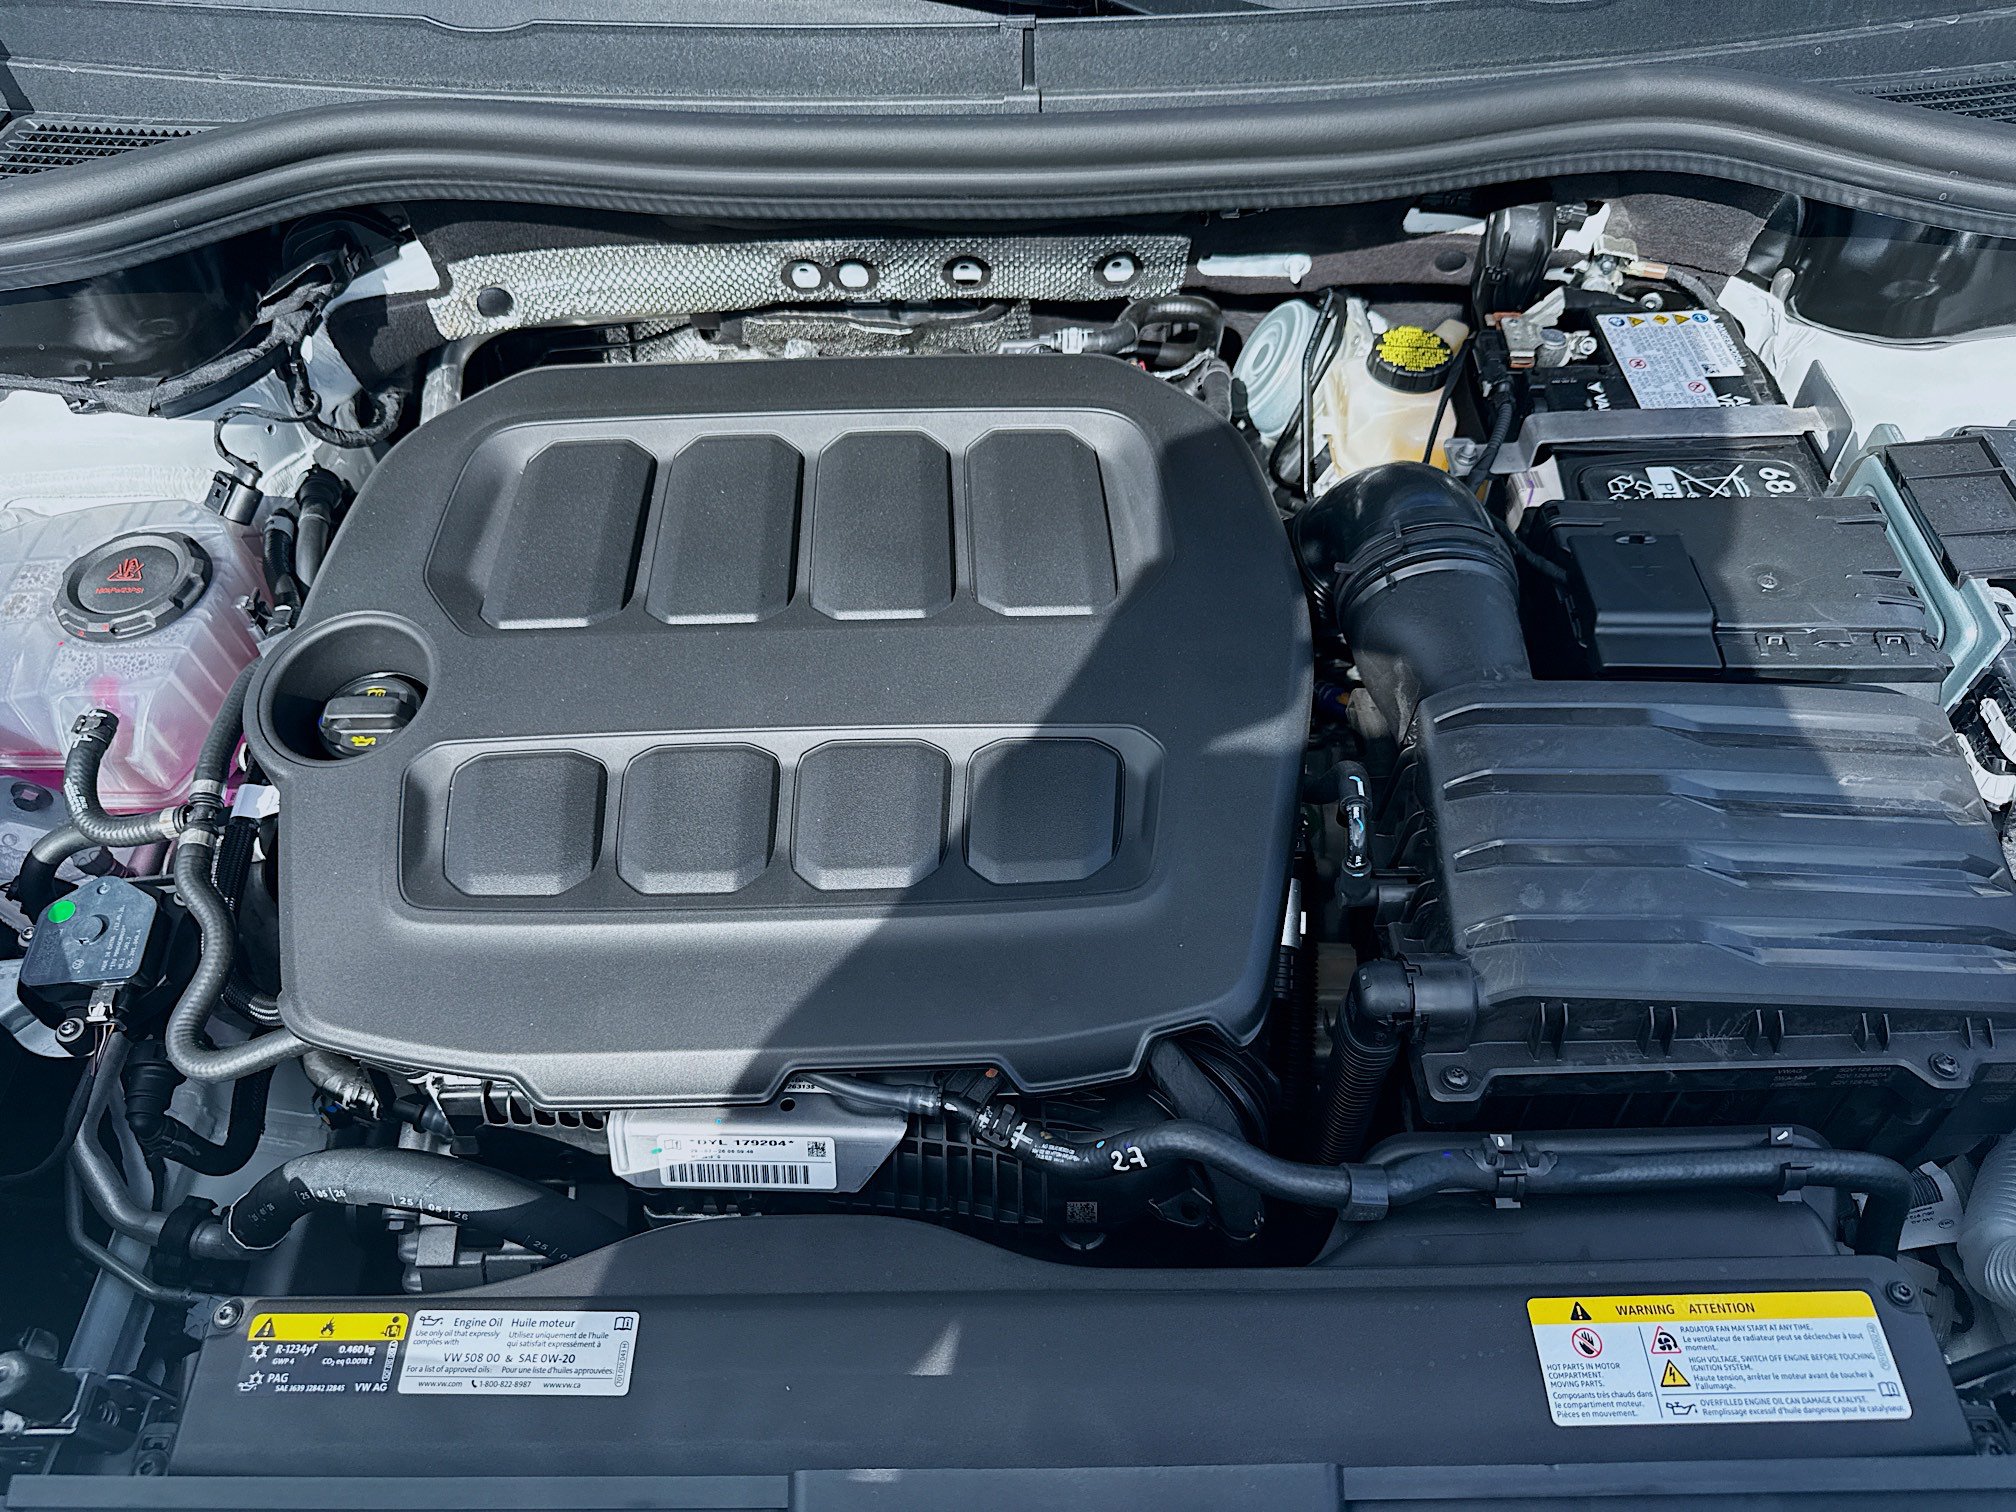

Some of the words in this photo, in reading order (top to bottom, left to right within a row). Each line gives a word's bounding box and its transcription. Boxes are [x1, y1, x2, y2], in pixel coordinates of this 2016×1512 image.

[1111, 1146, 1148, 1171] 27
[400, 1197, 414, 1206] 25
[454, 1211, 469, 1221] 26
[1616, 1304, 1675, 1316] WARNING
[1689, 1302, 1755, 1314] ATTENTION
[454, 1318, 487, 1329] Engine
[489, 1317, 503, 1327] Oil
[511, 1318, 537, 1328] Huile
[539, 1319, 576, 1328] moteur
[429, 1330, 443, 1338] only
[469, 1330, 500, 1339] expressly
[535, 1332, 576, 1340] uniquement
[1777, 1334, 1792, 1342] peut
[1803, 1332, 1840, 1340] déclencher
[413, 1339, 443, 1347] complies
[548, 1341, 595, 1349] expressément
[276, 1344, 318, 1356] R-1234yf
[339, 1345, 363, 1354] 0.460
[364, 1345, 376, 1356] kg
[444, 1353, 462, 1362] VW
[464, 1353, 483, 1362] 508
[486, 1353, 500, 1362] 00
[505, 1354, 513, 1362] &
[519, 1354, 538, 1363] SAE
[541, 1354, 576, 1363] 0W-20
[1769, 1354, 1782, 1362] OFF
[1840, 1352, 1875, 1360] TOUCHING
[336, 1359, 344, 1367] eq
[1595, 1362, 1620, 1370] MOTOR
[437, 1365, 444, 1373] of
[445, 1366, 477, 1374] approved
[502, 1366, 518, 1374] Pour
[533, 1366, 546, 1374] liste
[548, 1366, 573, 1374] d'huiles
[267, 1373, 289, 1383] PAG
[355, 1383, 372, 1392] VW
[372, 1383, 388, 1392] AG
[480, 1380, 532, 1388] 1-800-822-8987
[1553, 1391, 1595, 1400] Composants
[1612, 1390, 1635, 1398] chauds
[1563, 1401, 1614, 1409] compartiment
[1701, 1398, 1743, 1406] OVERFILLED
[1745, 1398, 1770, 1406] ENGINE
[1802, 1396, 1831, 1404] DAMAGE
[1557, 1410, 1580, 1418] Pièces
[1702, 1408, 1747, 1417] Remplissage
[1749, 1407, 1776, 1415] excessif
[1803, 1406, 1840, 1415] dangereux
